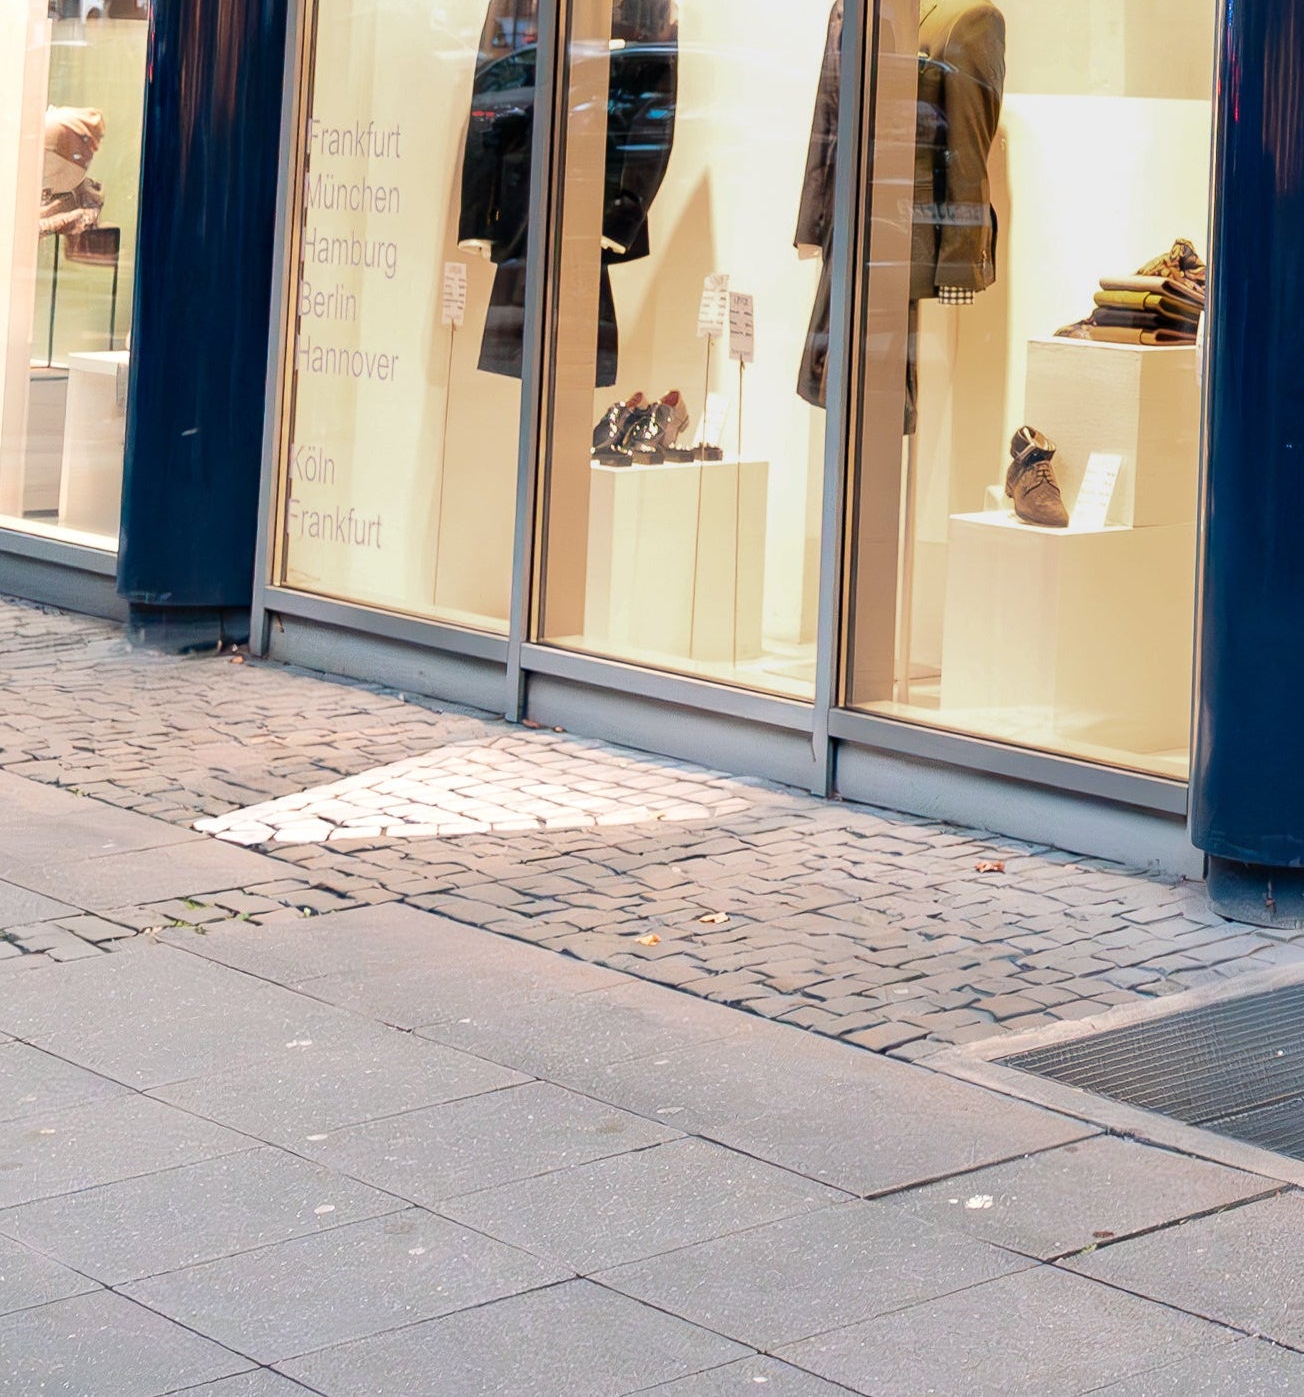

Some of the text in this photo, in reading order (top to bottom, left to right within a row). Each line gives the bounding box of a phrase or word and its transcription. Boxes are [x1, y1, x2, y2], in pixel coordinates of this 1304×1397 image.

[307, 118, 401, 159] Frankfurt
[304, 172, 400, 214] München
[301, 226, 398, 279] Hamburg
[299, 280, 357, 322] Berlin
[296, 334, 400, 382] Hannover
[289, 443, 335, 484] Köln
[287, 498, 383, 549] Frankfurt
